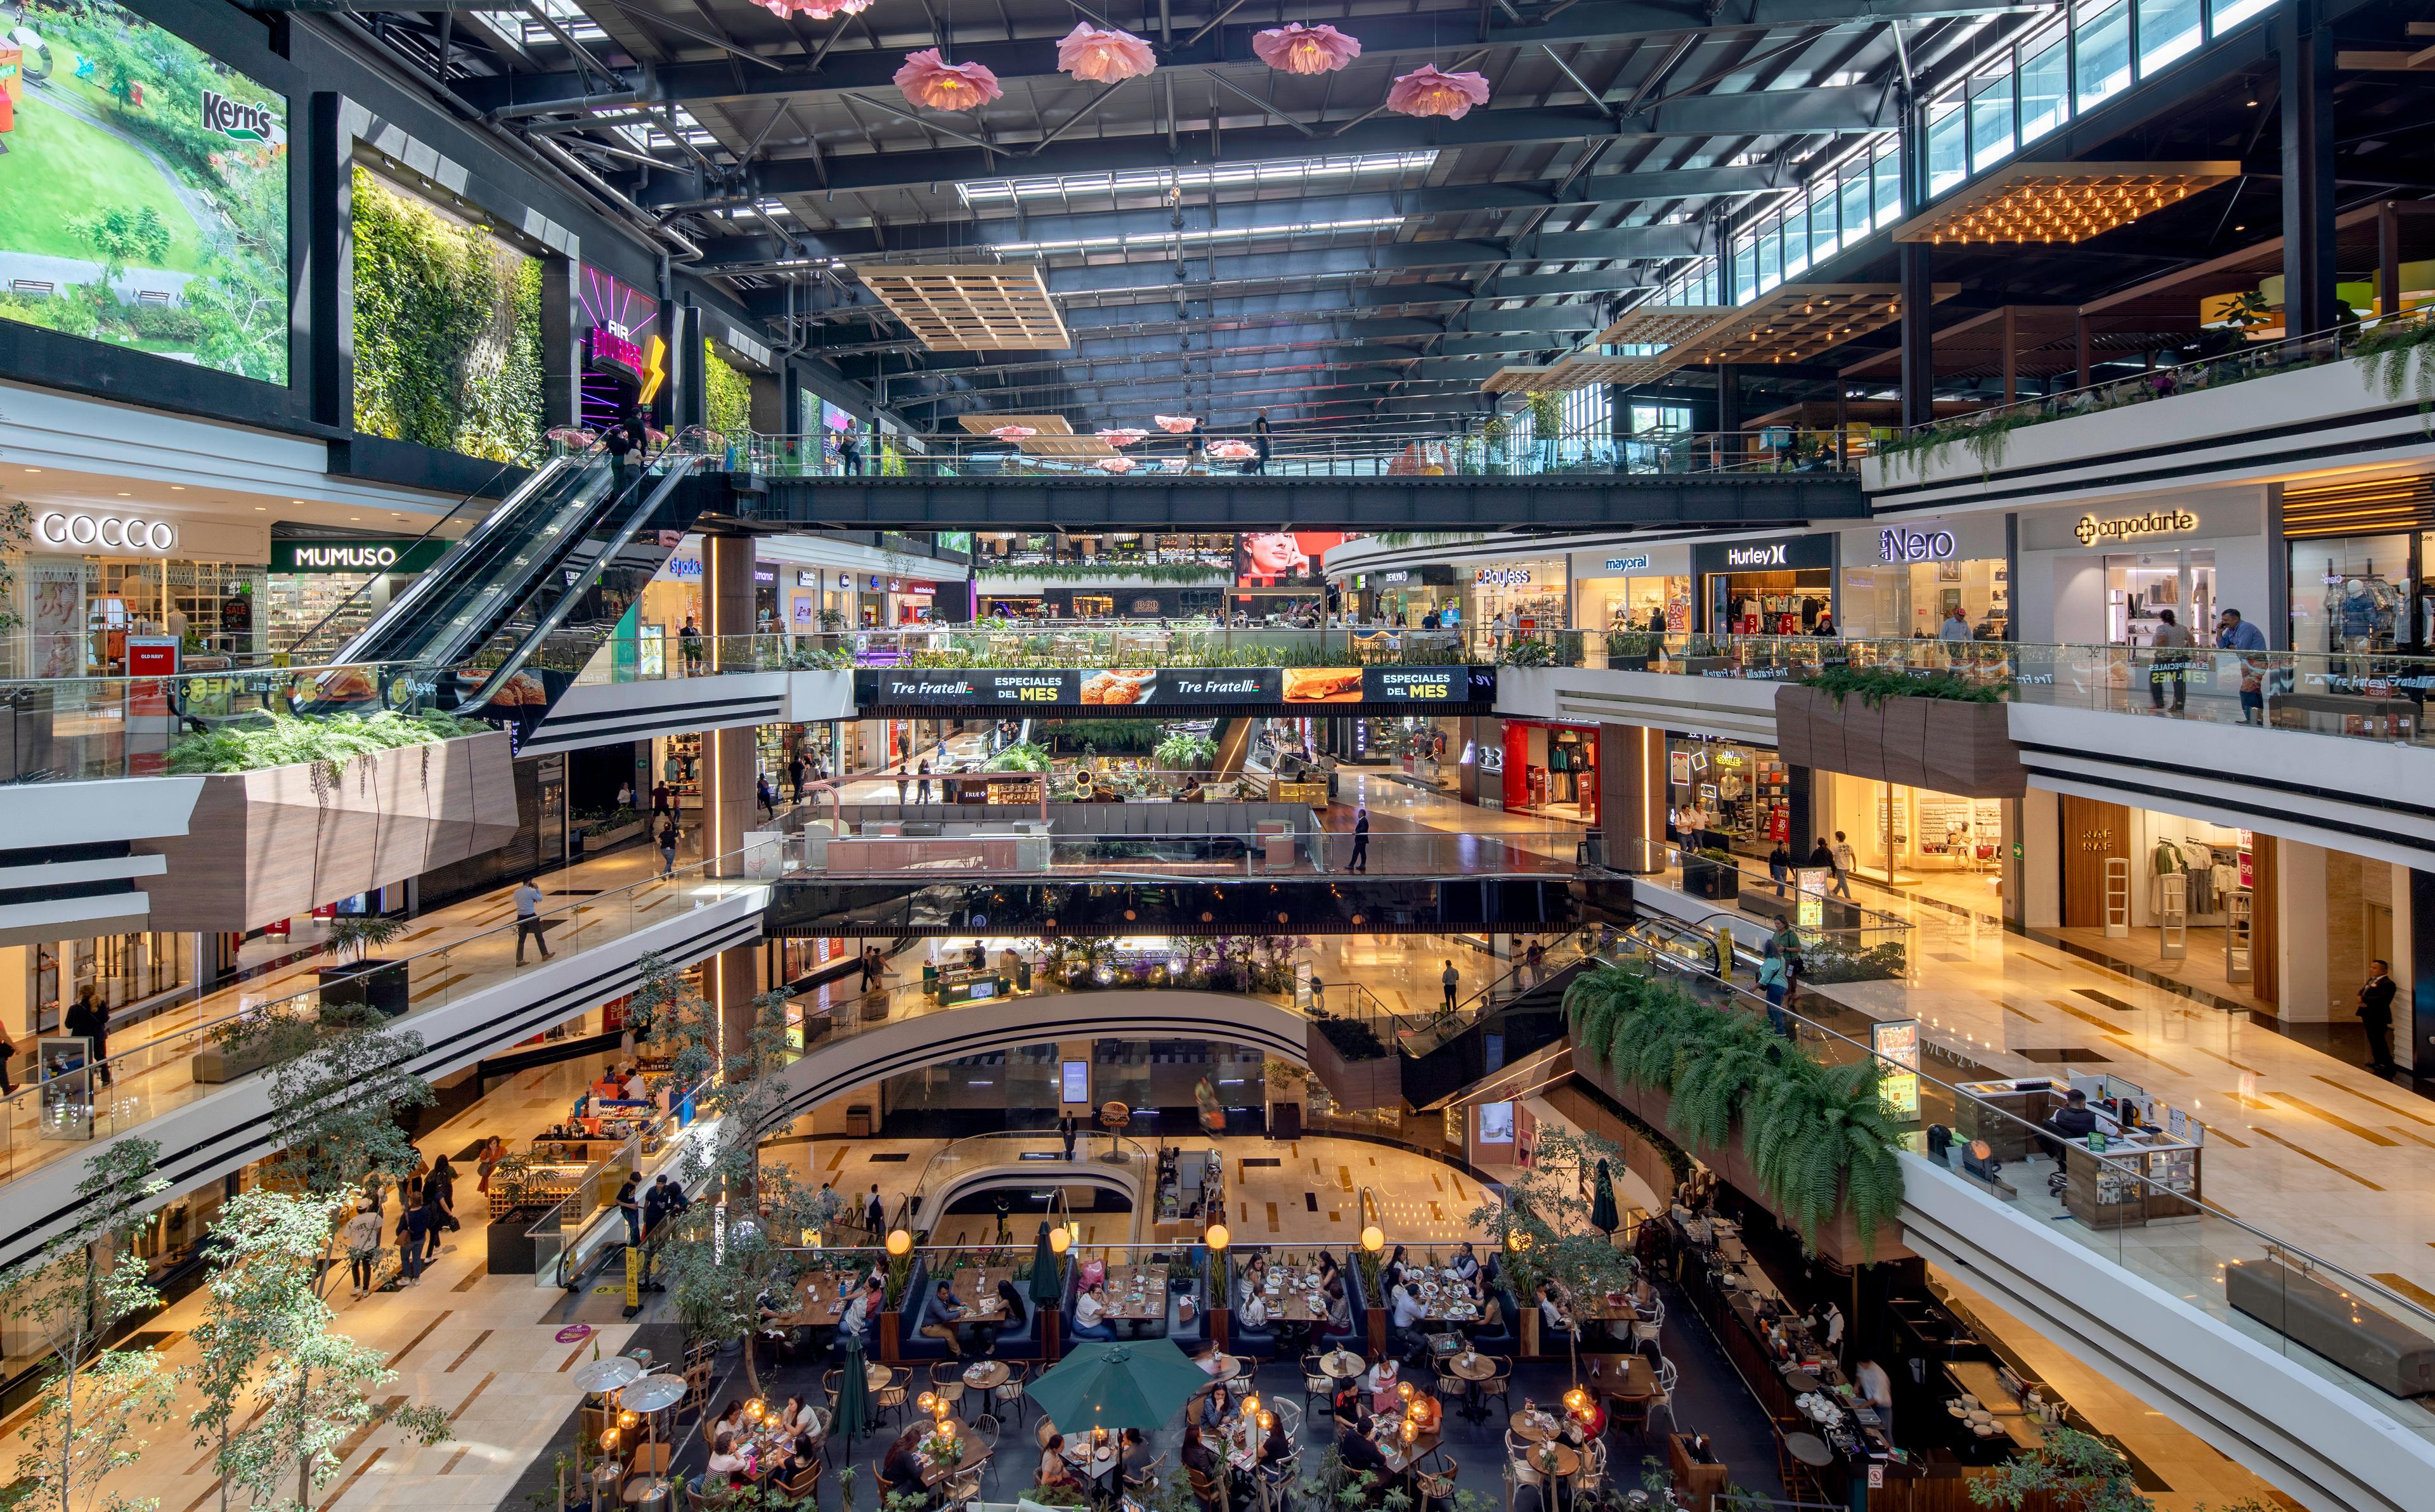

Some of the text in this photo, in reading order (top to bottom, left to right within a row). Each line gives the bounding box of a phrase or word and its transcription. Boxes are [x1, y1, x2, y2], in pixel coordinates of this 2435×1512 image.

[202, 89, 272, 138] Kern's
[609, 319, 629, 342] AIR
[2098, 510, 2192, 539] capodarte
[43, 513, 174, 550] GOCCO
[1886, 529, 1954, 560] Nero
[295, 547, 397, 566] MUMUSO
[1729, 546, 1771, 565] Hurley
[1606, 554, 1649, 571] mayoral
[1386, 574, 1403, 582] DEVLYN
[1484, 568, 1529, 588] Payless
[226, 606, 246, 615] SALE
[994, 677, 1062, 686] ESPECIALES
[1383, 674, 1450, 684] ESPECIALES
[892, 682, 968, 694] Tre Fratelli
[1178, 680, 1254, 693] Tre Fratelli
[1387, 685, 1448, 698] DEL MES
[1020, 688, 1058, 701] MES
[1717, 754, 1742, 766] SALE
[2083, 830, 2112, 838] NAF
[2084, 843, 2113, 851] NAF
